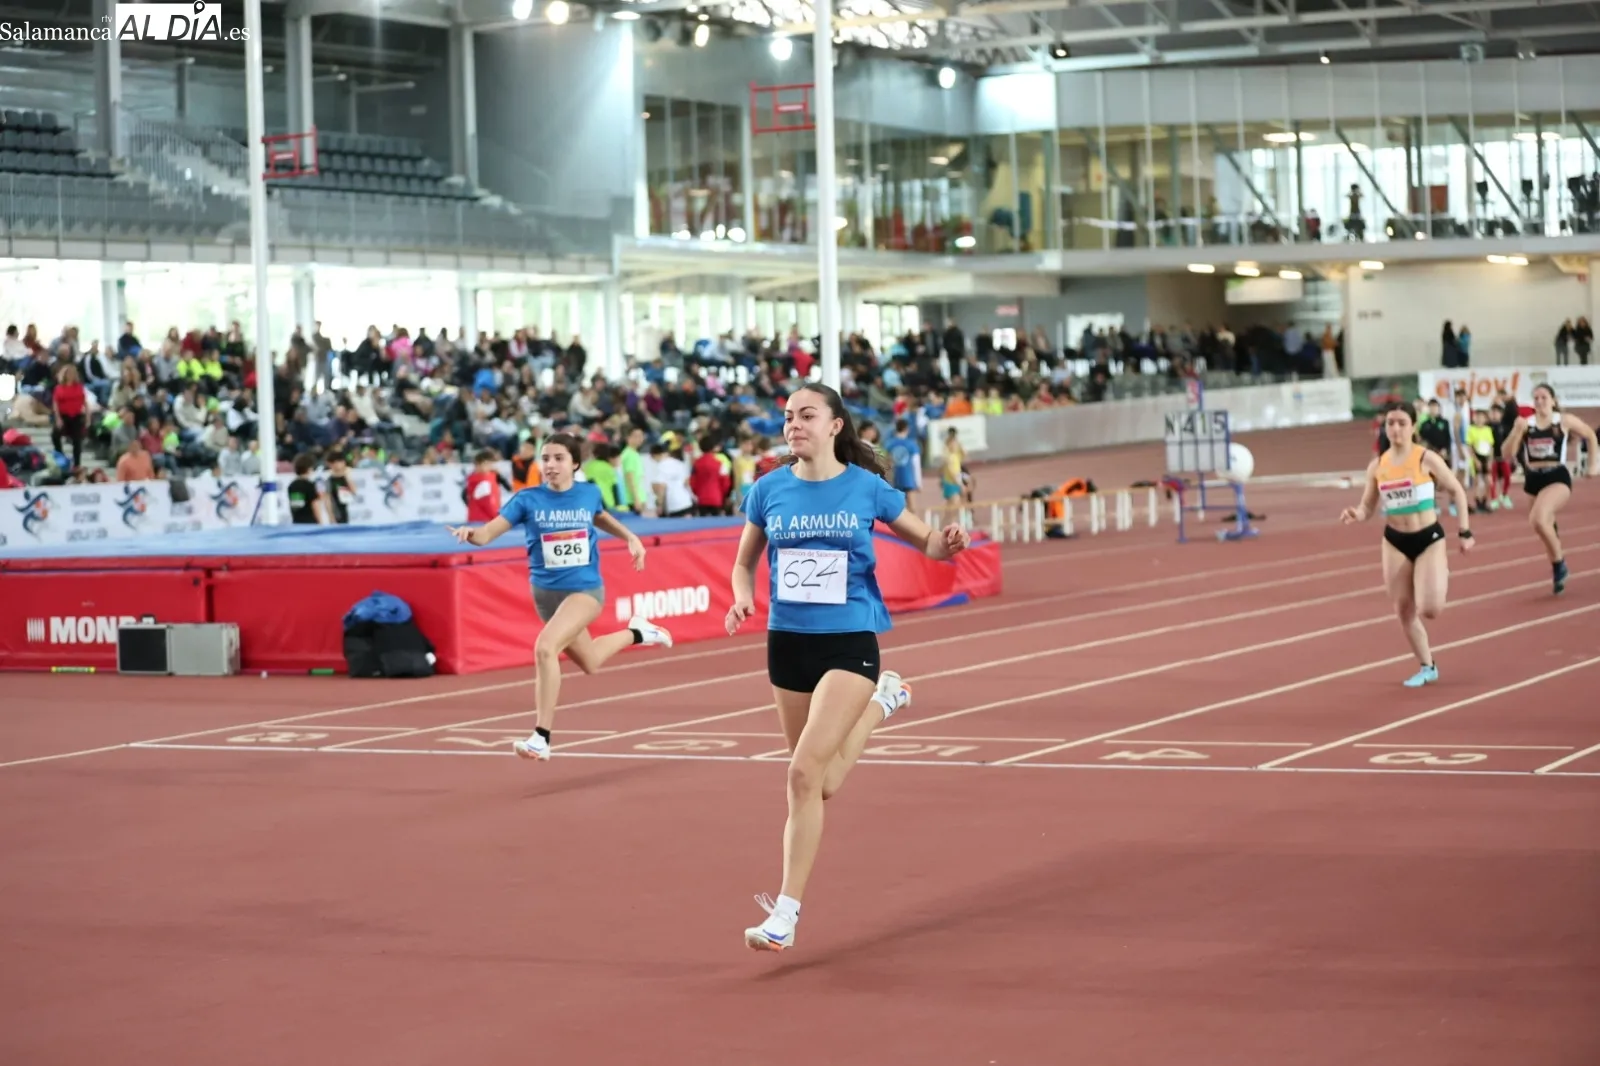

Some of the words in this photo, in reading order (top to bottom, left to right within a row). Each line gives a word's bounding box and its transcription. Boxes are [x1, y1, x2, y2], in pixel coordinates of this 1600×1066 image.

[534, 509, 546, 522] LA
[548, 508, 592, 523] ARMUÑA
[768, 515, 782, 531] LA
[788, 510, 859, 530] ARMUÑA
[774, 531, 796, 539] CLUB
[799, 530, 853, 539] DEPORTIVO
[553, 543, 582, 556] 626
[784, 558, 839, 590] 624
[633, 585, 709, 620] MONDO
[50, 616, 155, 644] MON
